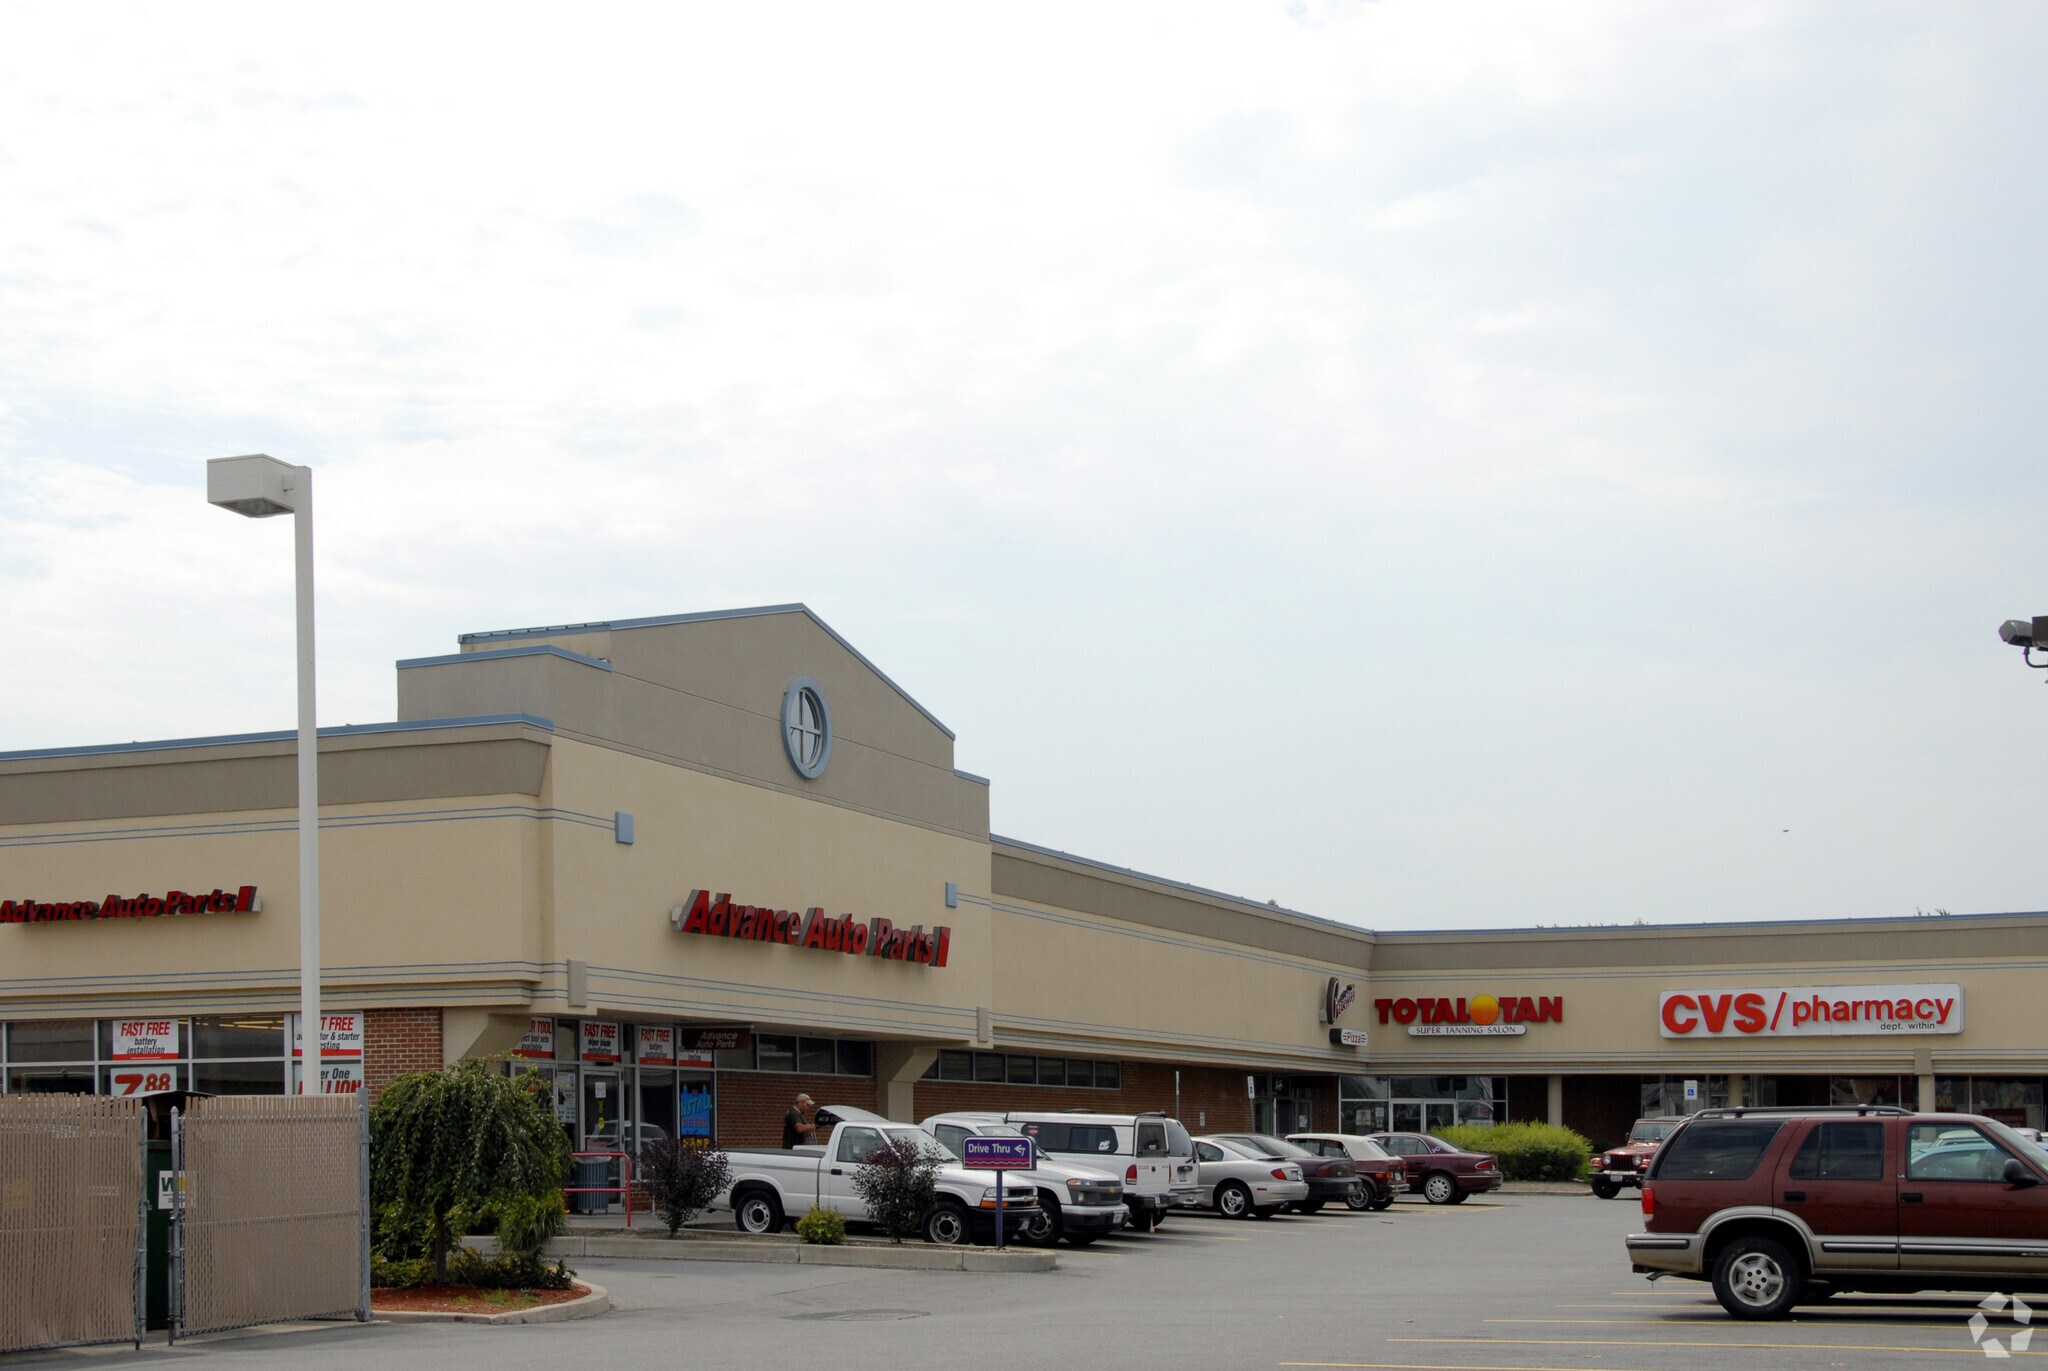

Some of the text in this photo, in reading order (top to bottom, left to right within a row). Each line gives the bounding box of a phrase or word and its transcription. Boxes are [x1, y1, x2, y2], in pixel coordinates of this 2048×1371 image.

[0, 889, 238, 923] Advance Auto Parts
[679, 889, 935, 964] Advance Auto Parts
[1375, 997, 1471, 1025] TOTAL
[1499, 996, 1564, 1024] TAN
[121, 1021, 171, 1037] FAST FREE
[329, 1016, 354, 1031] FREE
[1880, 1021, 1936, 1031] dept. within
[584, 1023, 616, 1039] FAST FREE
[641, 1028, 670, 1043] FAST FREE
[700, 1031, 738, 1040] Advance
[1416, 1026, 1516, 1034] SUPER TANNING SALON
[134, 1037, 157, 1047] battery
[337, 1032, 360, 1041] starter
[1346, 1031, 1361, 1044] Pizza
[320, 1041, 340, 1051] esting
[696, 1039, 736, 1049] Auto Parts
[127, 1046, 165, 1055] installation
[332, 1068, 350, 1080] One
[968, 1143, 1011, 1154] Drive Thru
